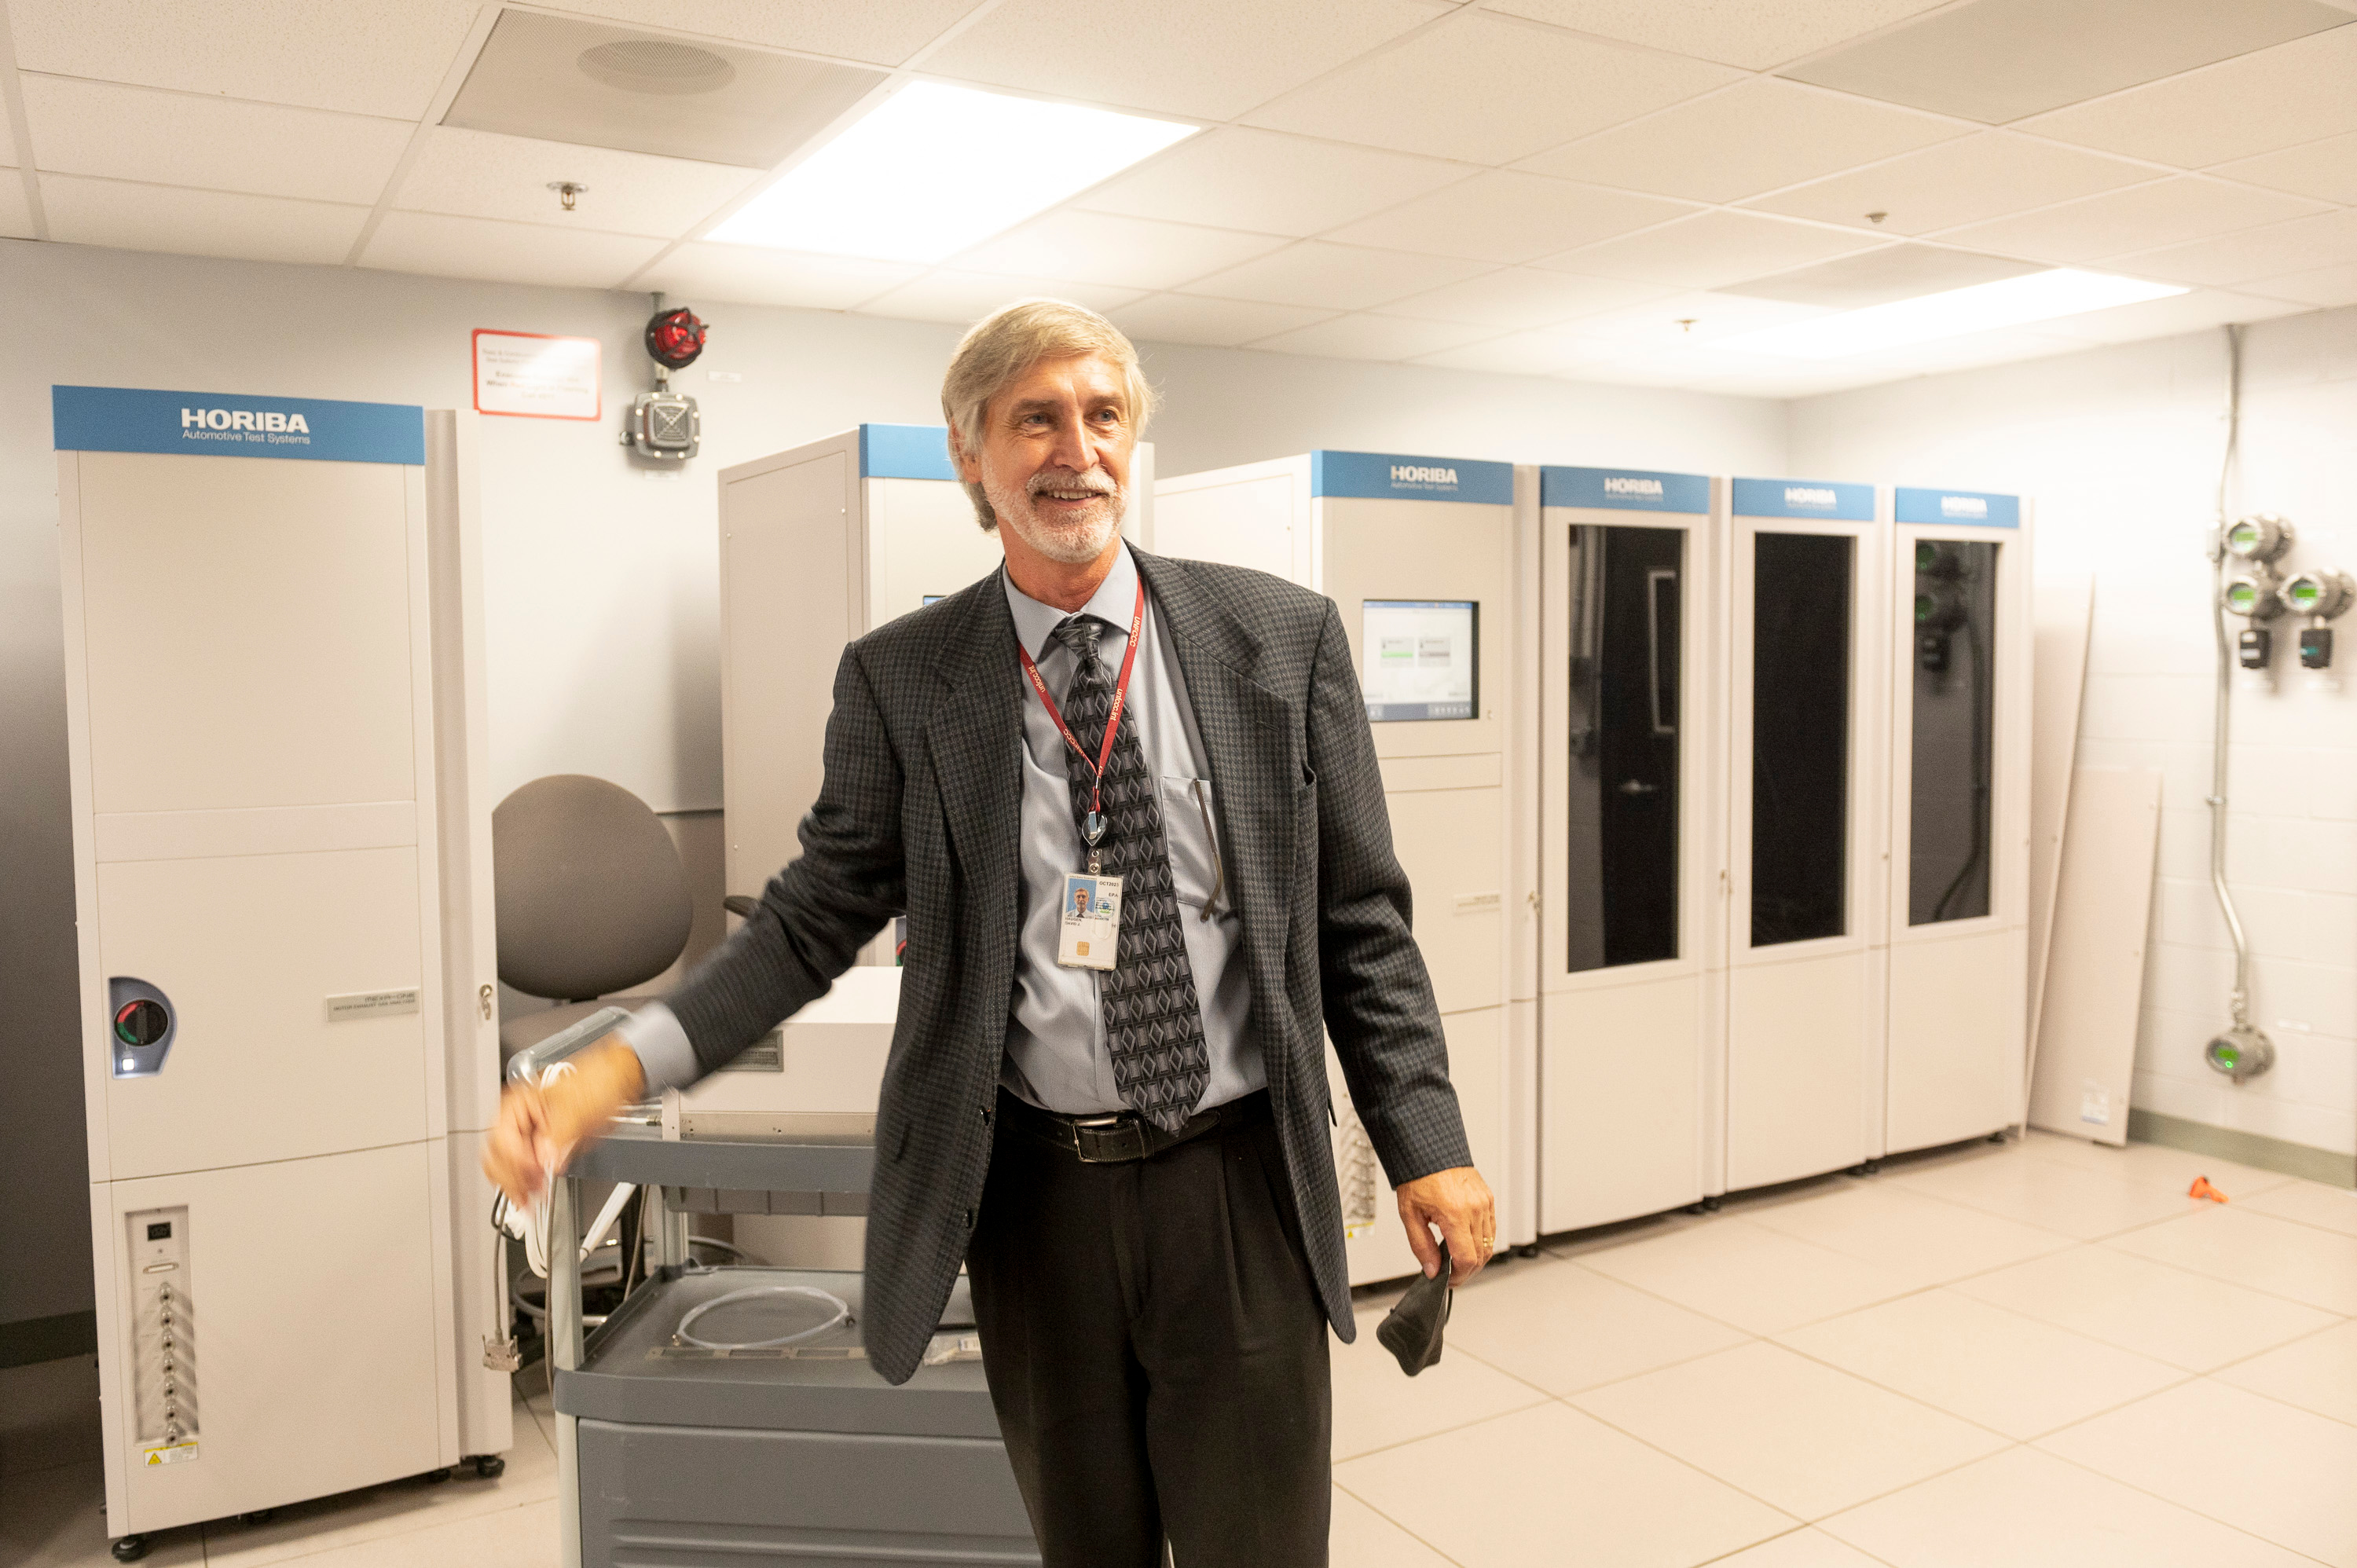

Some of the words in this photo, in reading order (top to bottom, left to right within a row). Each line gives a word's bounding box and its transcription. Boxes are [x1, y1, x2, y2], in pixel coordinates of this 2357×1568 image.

[181, 408, 310, 434] HORIBA
[182, 430, 242, 441] Automotive
[244, 432, 265, 442] Test
[267, 433, 310, 445] Systems
[1391, 465, 1458, 484] HORIBA
[1604, 478, 1663, 494] HORIBA
[1130, 616, 1141, 647] UNFCCC
[1028, 665, 1046, 693] unfccc.int
[1109, 688, 1123, 721] unfccc.int
